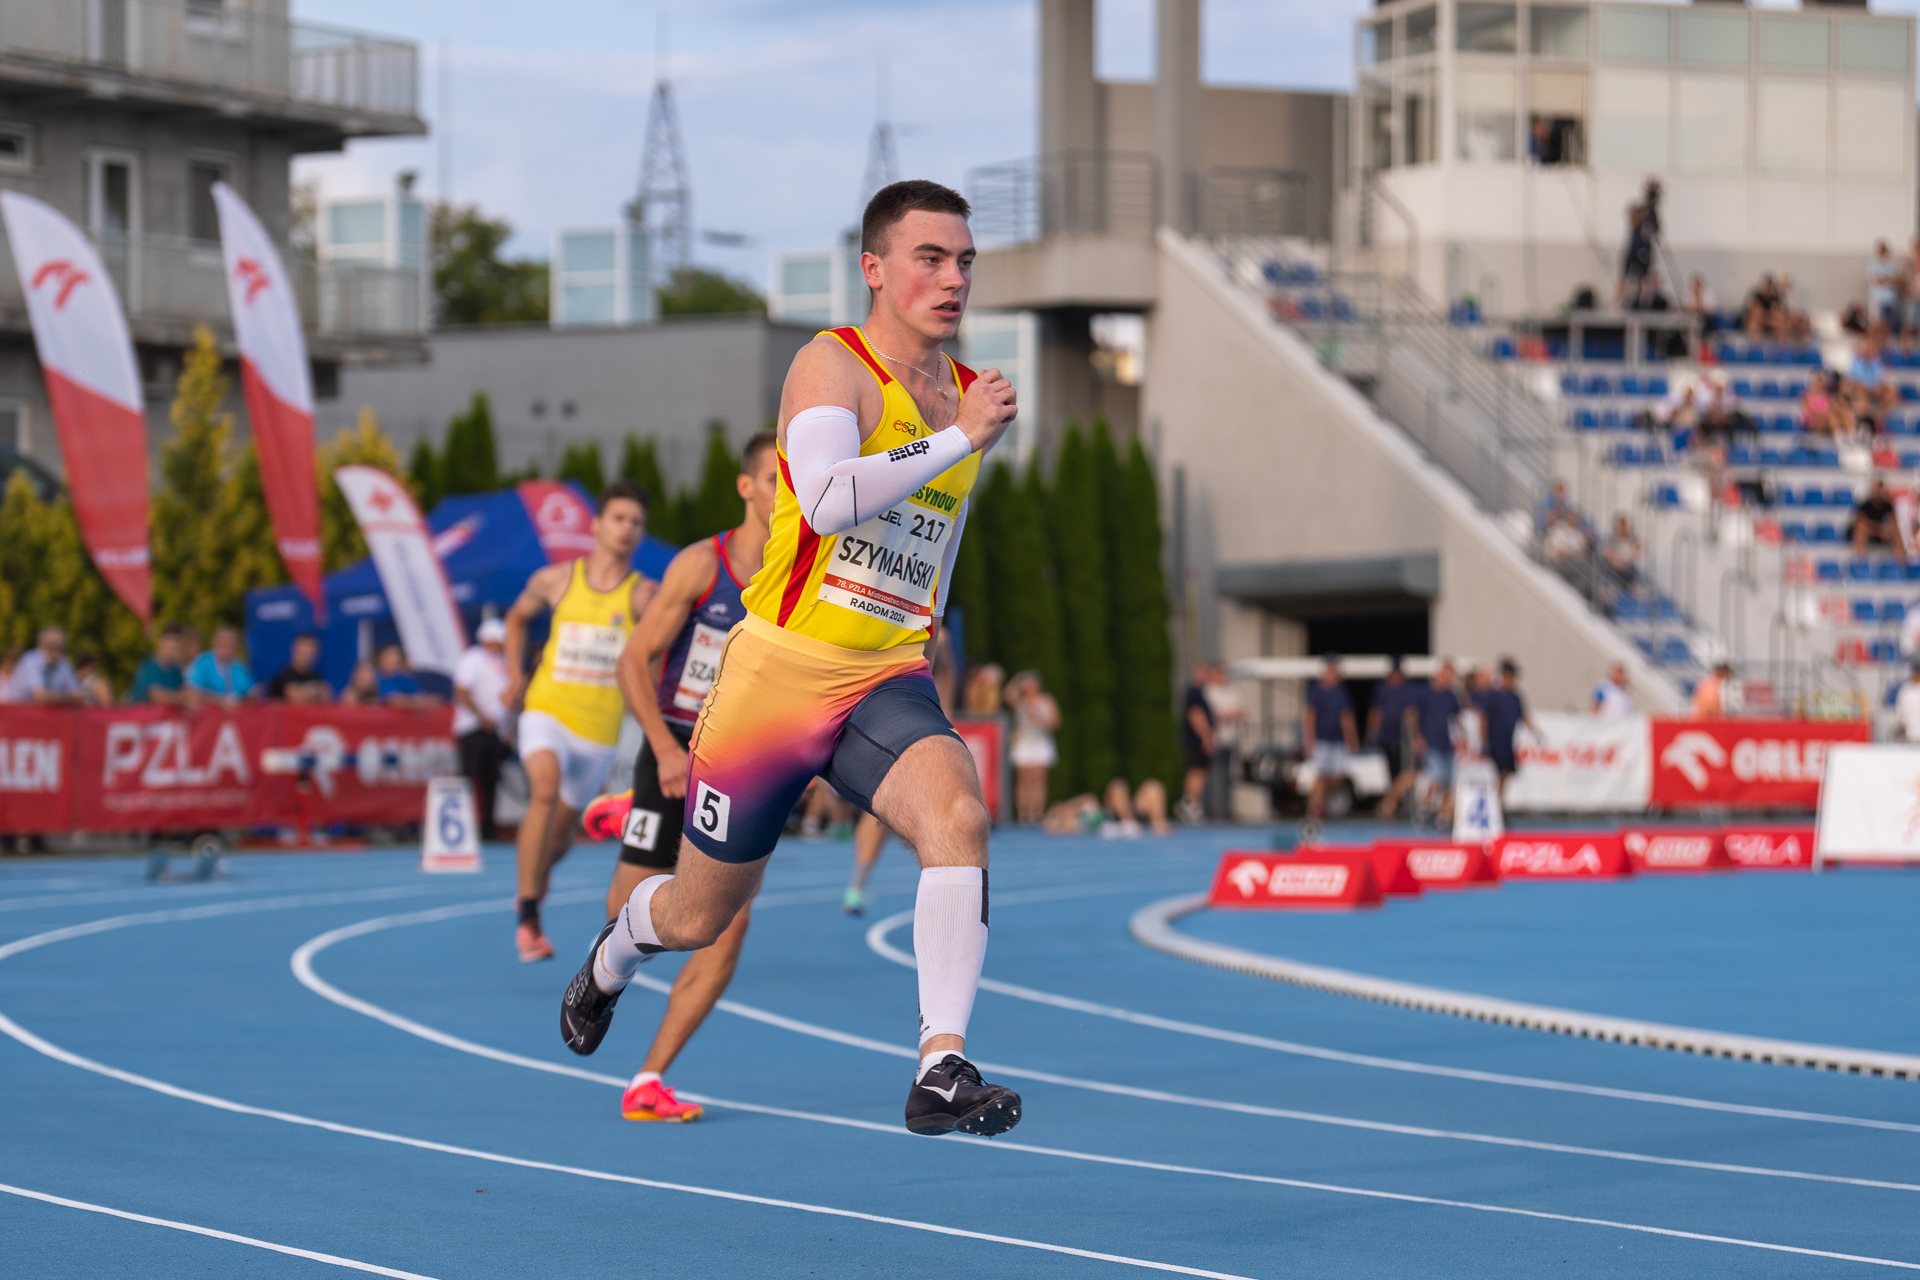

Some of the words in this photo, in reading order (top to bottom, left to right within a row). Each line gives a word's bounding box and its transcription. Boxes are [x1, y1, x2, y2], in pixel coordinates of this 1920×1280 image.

[893, 419, 917, 437] esa
[911, 485, 958, 513] SYNÓW
[909, 513, 946, 544] 217
[837, 535, 935, 590] SZYMAŃSKI
[836, 578, 848, 589] 78.
[848, 583, 867, 595] PZLA
[849, 597, 890, 618] RADOM
[889, 610, 906, 624] 2024
[103, 721, 250, 789] PZLA
[1731, 738, 1824, 784] ORLE
[438, 794, 466, 850] 6
[700, 789, 721, 833] 5
[1467, 786, 1490, 830] 4
[631, 815, 648, 843] 4
